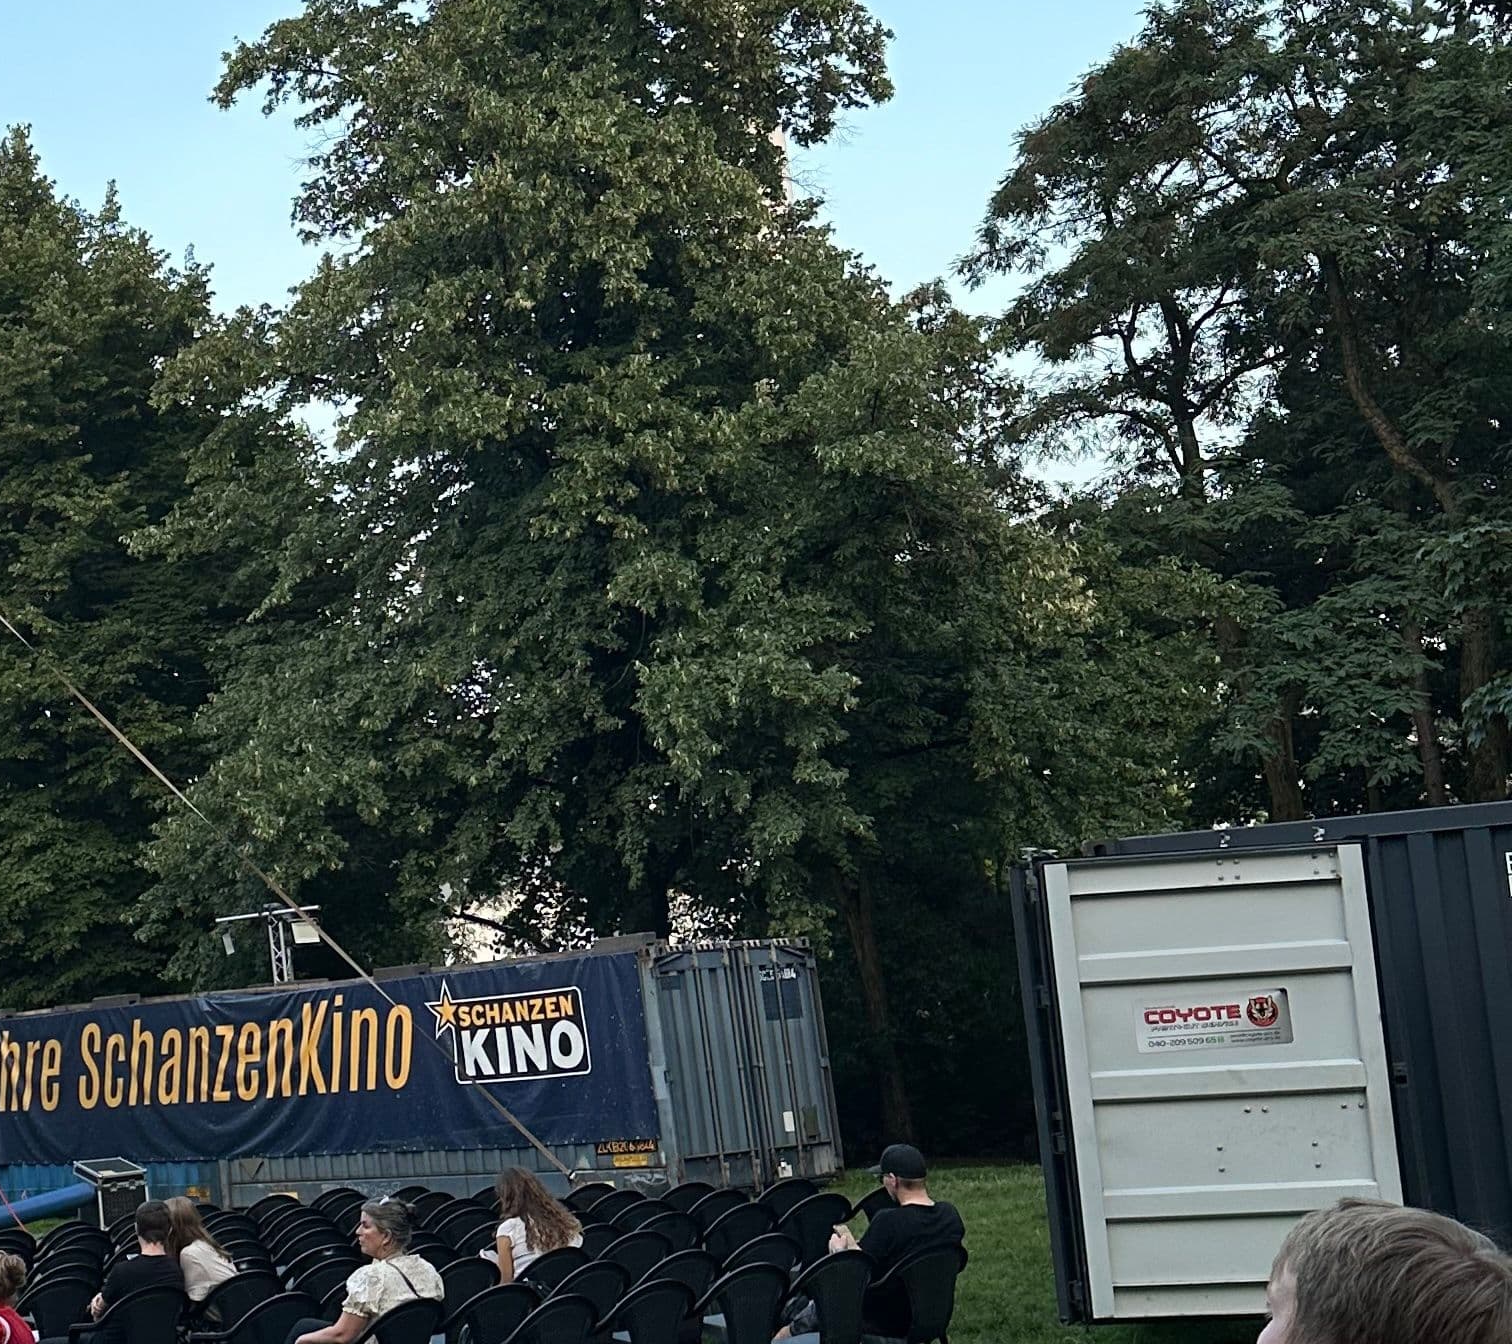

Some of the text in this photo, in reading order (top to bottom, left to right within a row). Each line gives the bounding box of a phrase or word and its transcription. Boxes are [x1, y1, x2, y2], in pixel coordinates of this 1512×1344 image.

[458, 994, 574, 1028] SCHANZEN
[1144, 1005, 1242, 1025] COYOTE
[461, 1020, 584, 1077] KINO
